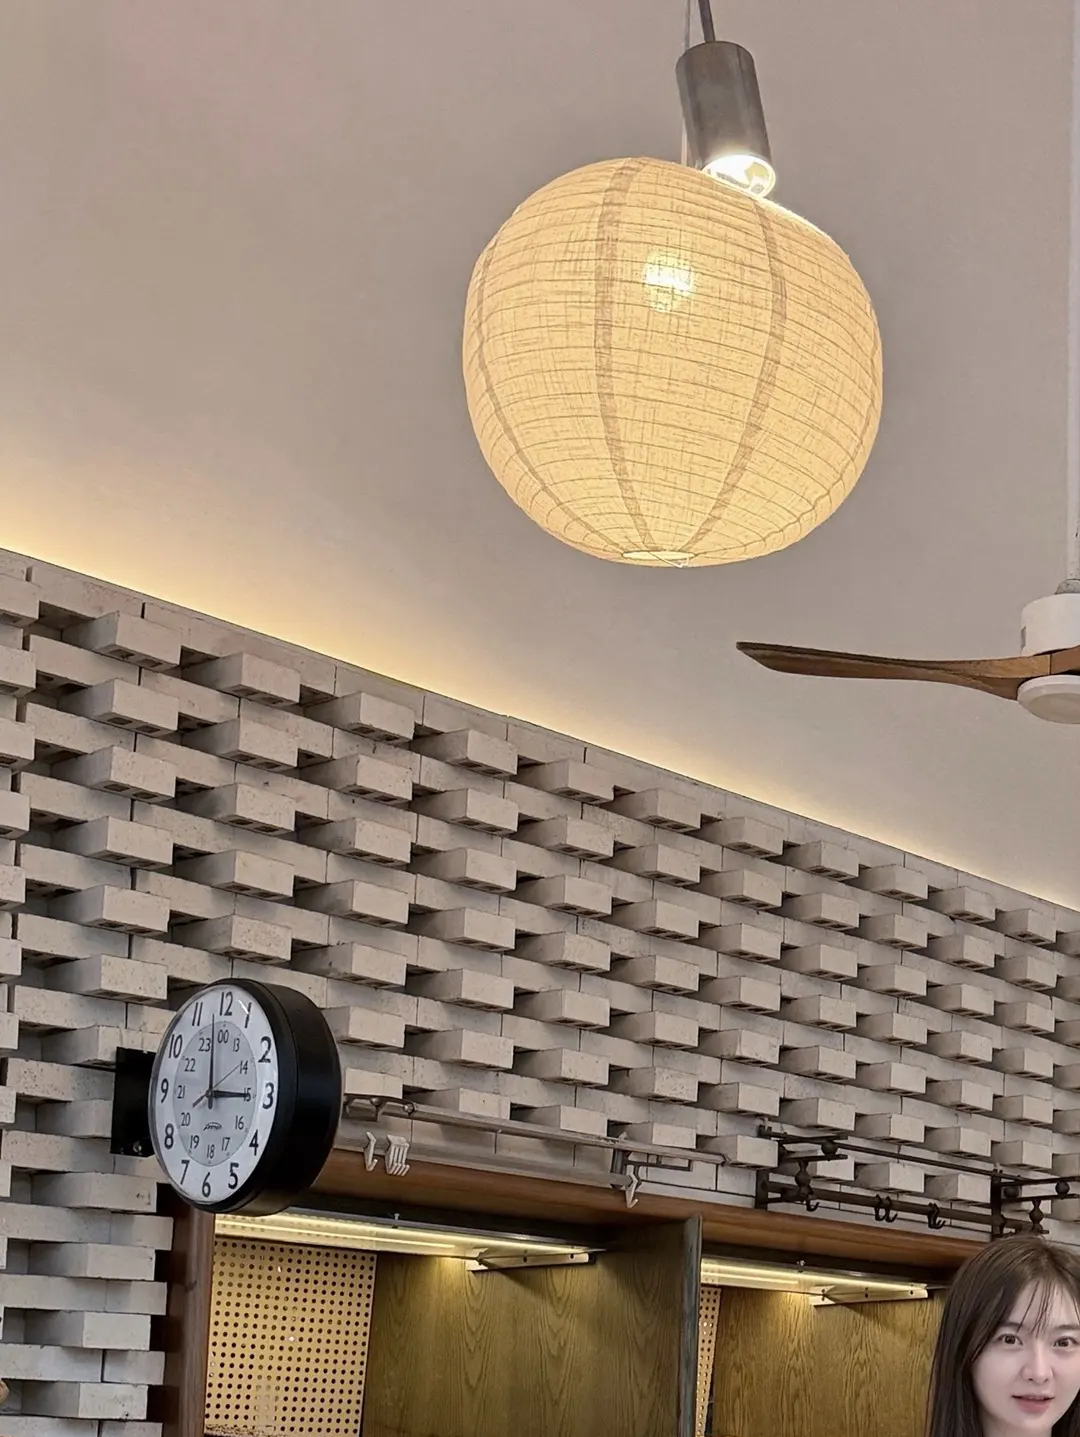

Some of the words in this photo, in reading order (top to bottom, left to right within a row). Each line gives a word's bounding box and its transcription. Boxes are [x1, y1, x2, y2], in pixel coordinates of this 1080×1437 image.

[192, 1002, 203, 1026] 11
[220, 992, 233, 1016] 12
[244, 1002, 252, 1028] 1
[168, 1035, 183, 1058] 10
[199, 1038, 211, 1052] 23
[218, 1029, 229, 1044] 00
[233, 1038, 240, 1052] 13
[258, 1036, 272, 1063] 2
[184, 1058, 195, 1072] 22
[239, 1060, 248, 1074] 14
[161, 1078, 169, 1103] 9
[177, 1085, 185, 1099] 21
[262, 1083, 275, 1109] 3
[181, 1113, 191, 1127] 20
[235, 1116, 244, 1130] 16
[164, 1124, 174, 1149] 8
[190, 1135, 200, 1149] 19
[221, 1137, 230, 1152] 17
[249, 1130, 259, 1156] 4
[206, 1145, 215, 1158] 18
[180, 1160, 190, 1185] 7
[228, 1163, 239, 1189] 5
[201, 1172, 211, 1197] 6
